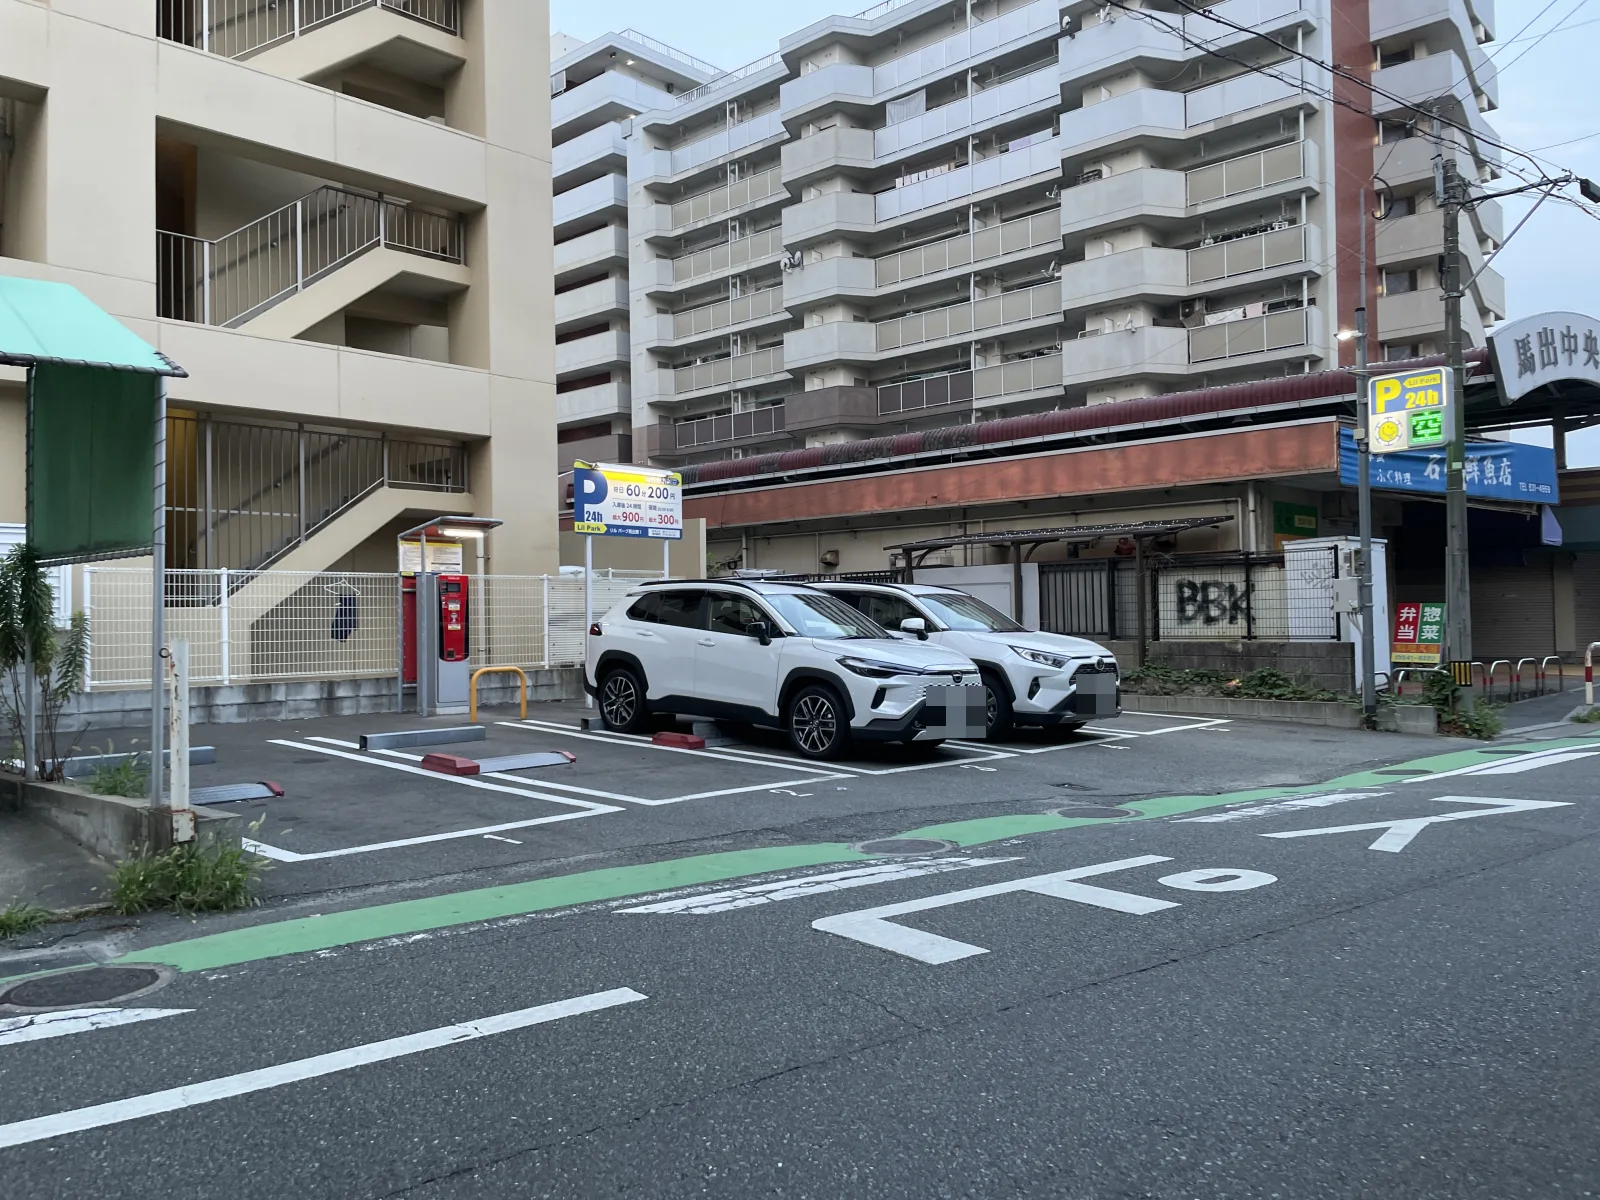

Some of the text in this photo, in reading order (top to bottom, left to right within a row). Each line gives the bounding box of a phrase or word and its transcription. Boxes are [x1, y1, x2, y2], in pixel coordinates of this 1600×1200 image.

[1513, 325, 1600, 379] 馬出中央
[1375, 379, 1402, 414] P
[1404, 389, 1439, 409] 24h
[1411, 411, 1443, 444] 空
[1424, 453, 1512, 487] 石鮮魚店
[574, 468, 609, 522] P
[585, 510, 603, 523] 24h
[586, 524, 601, 532] Park
[1397, 606, 1417, 640] 弁当
[1420, 606, 1442, 640] 惣菜
